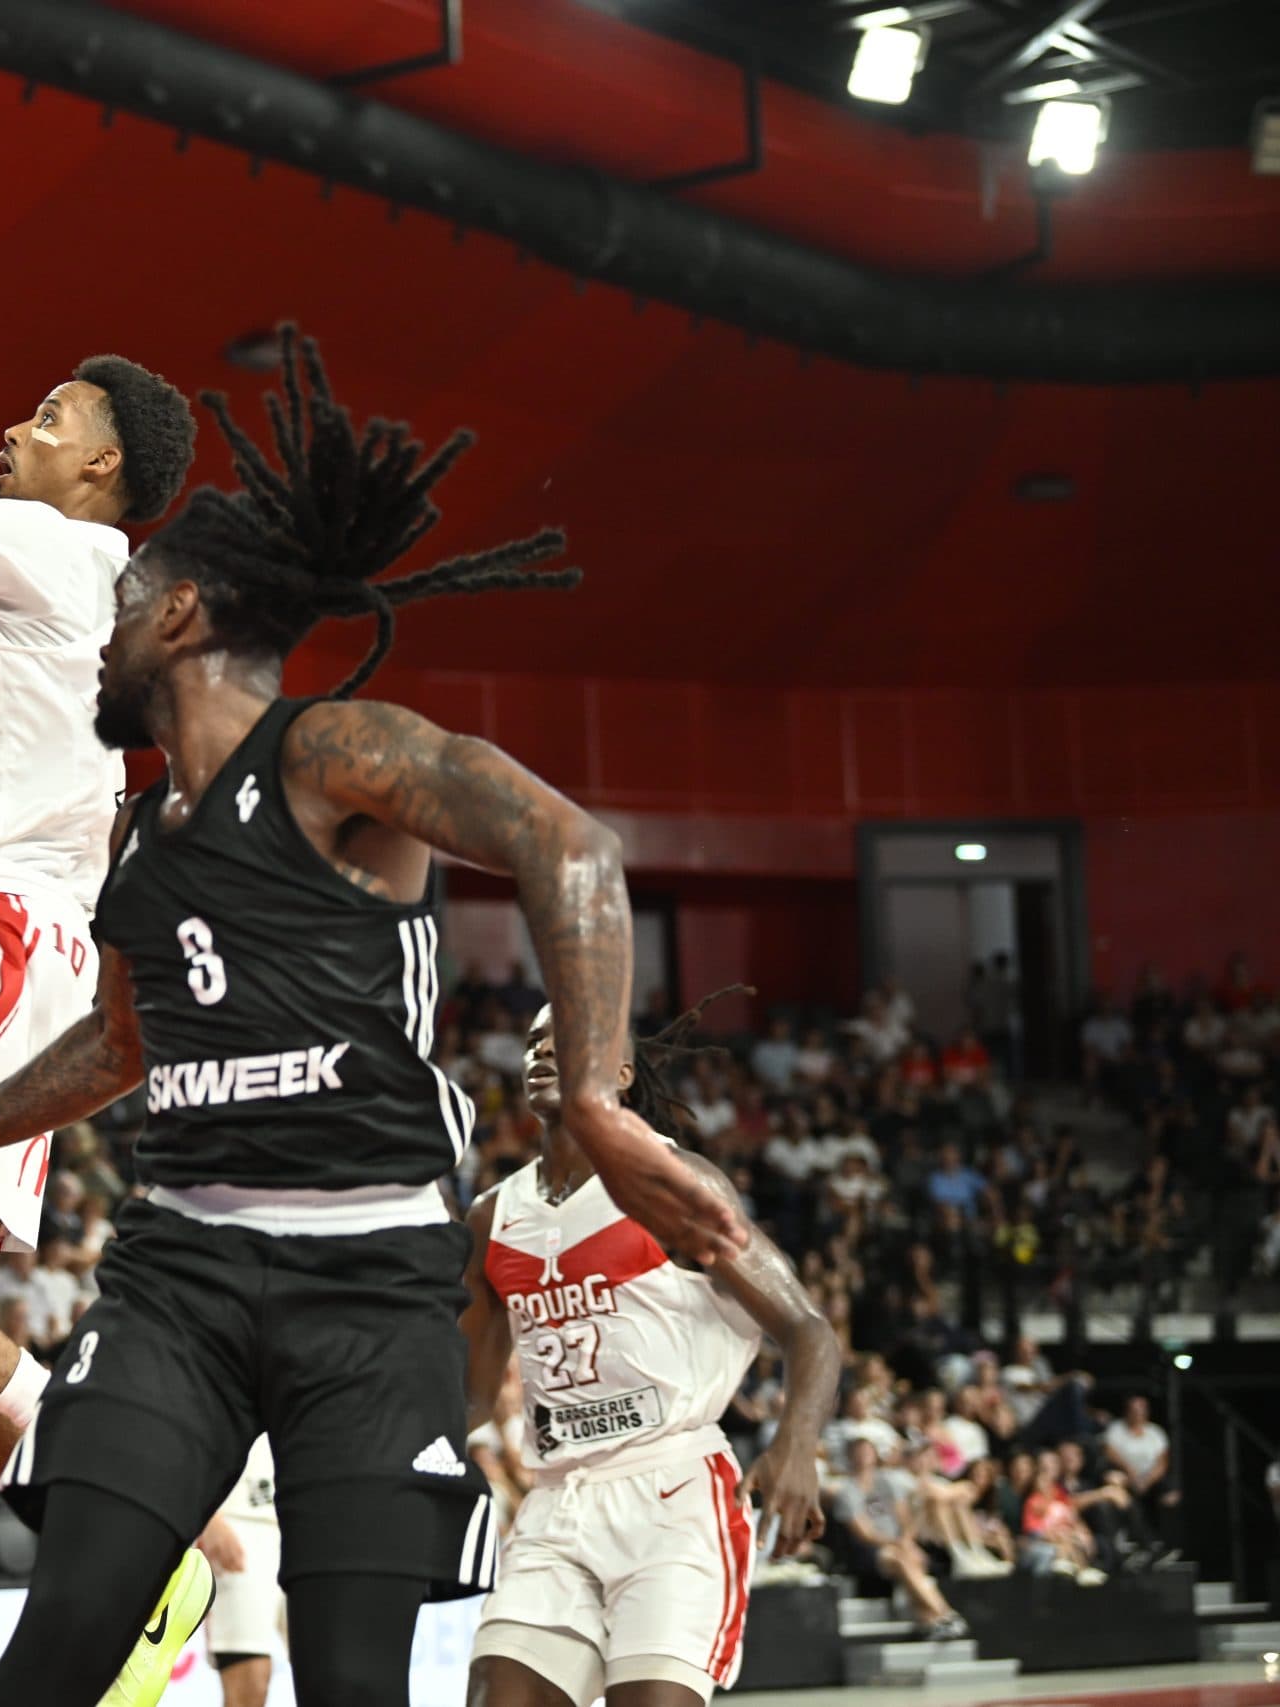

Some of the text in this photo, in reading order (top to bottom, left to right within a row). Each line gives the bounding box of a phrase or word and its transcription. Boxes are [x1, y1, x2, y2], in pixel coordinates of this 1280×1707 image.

[52, 922, 86, 977] 10
[176, 916, 227, 1005] 3
[148, 1041, 350, 1114] SKWEEK
[507, 1273, 617, 1333] BOURG
[66, 1330, 99, 1384] 3
[536, 1323, 600, 1391] 27
[572, 1412, 643, 1439] LOISIRS
